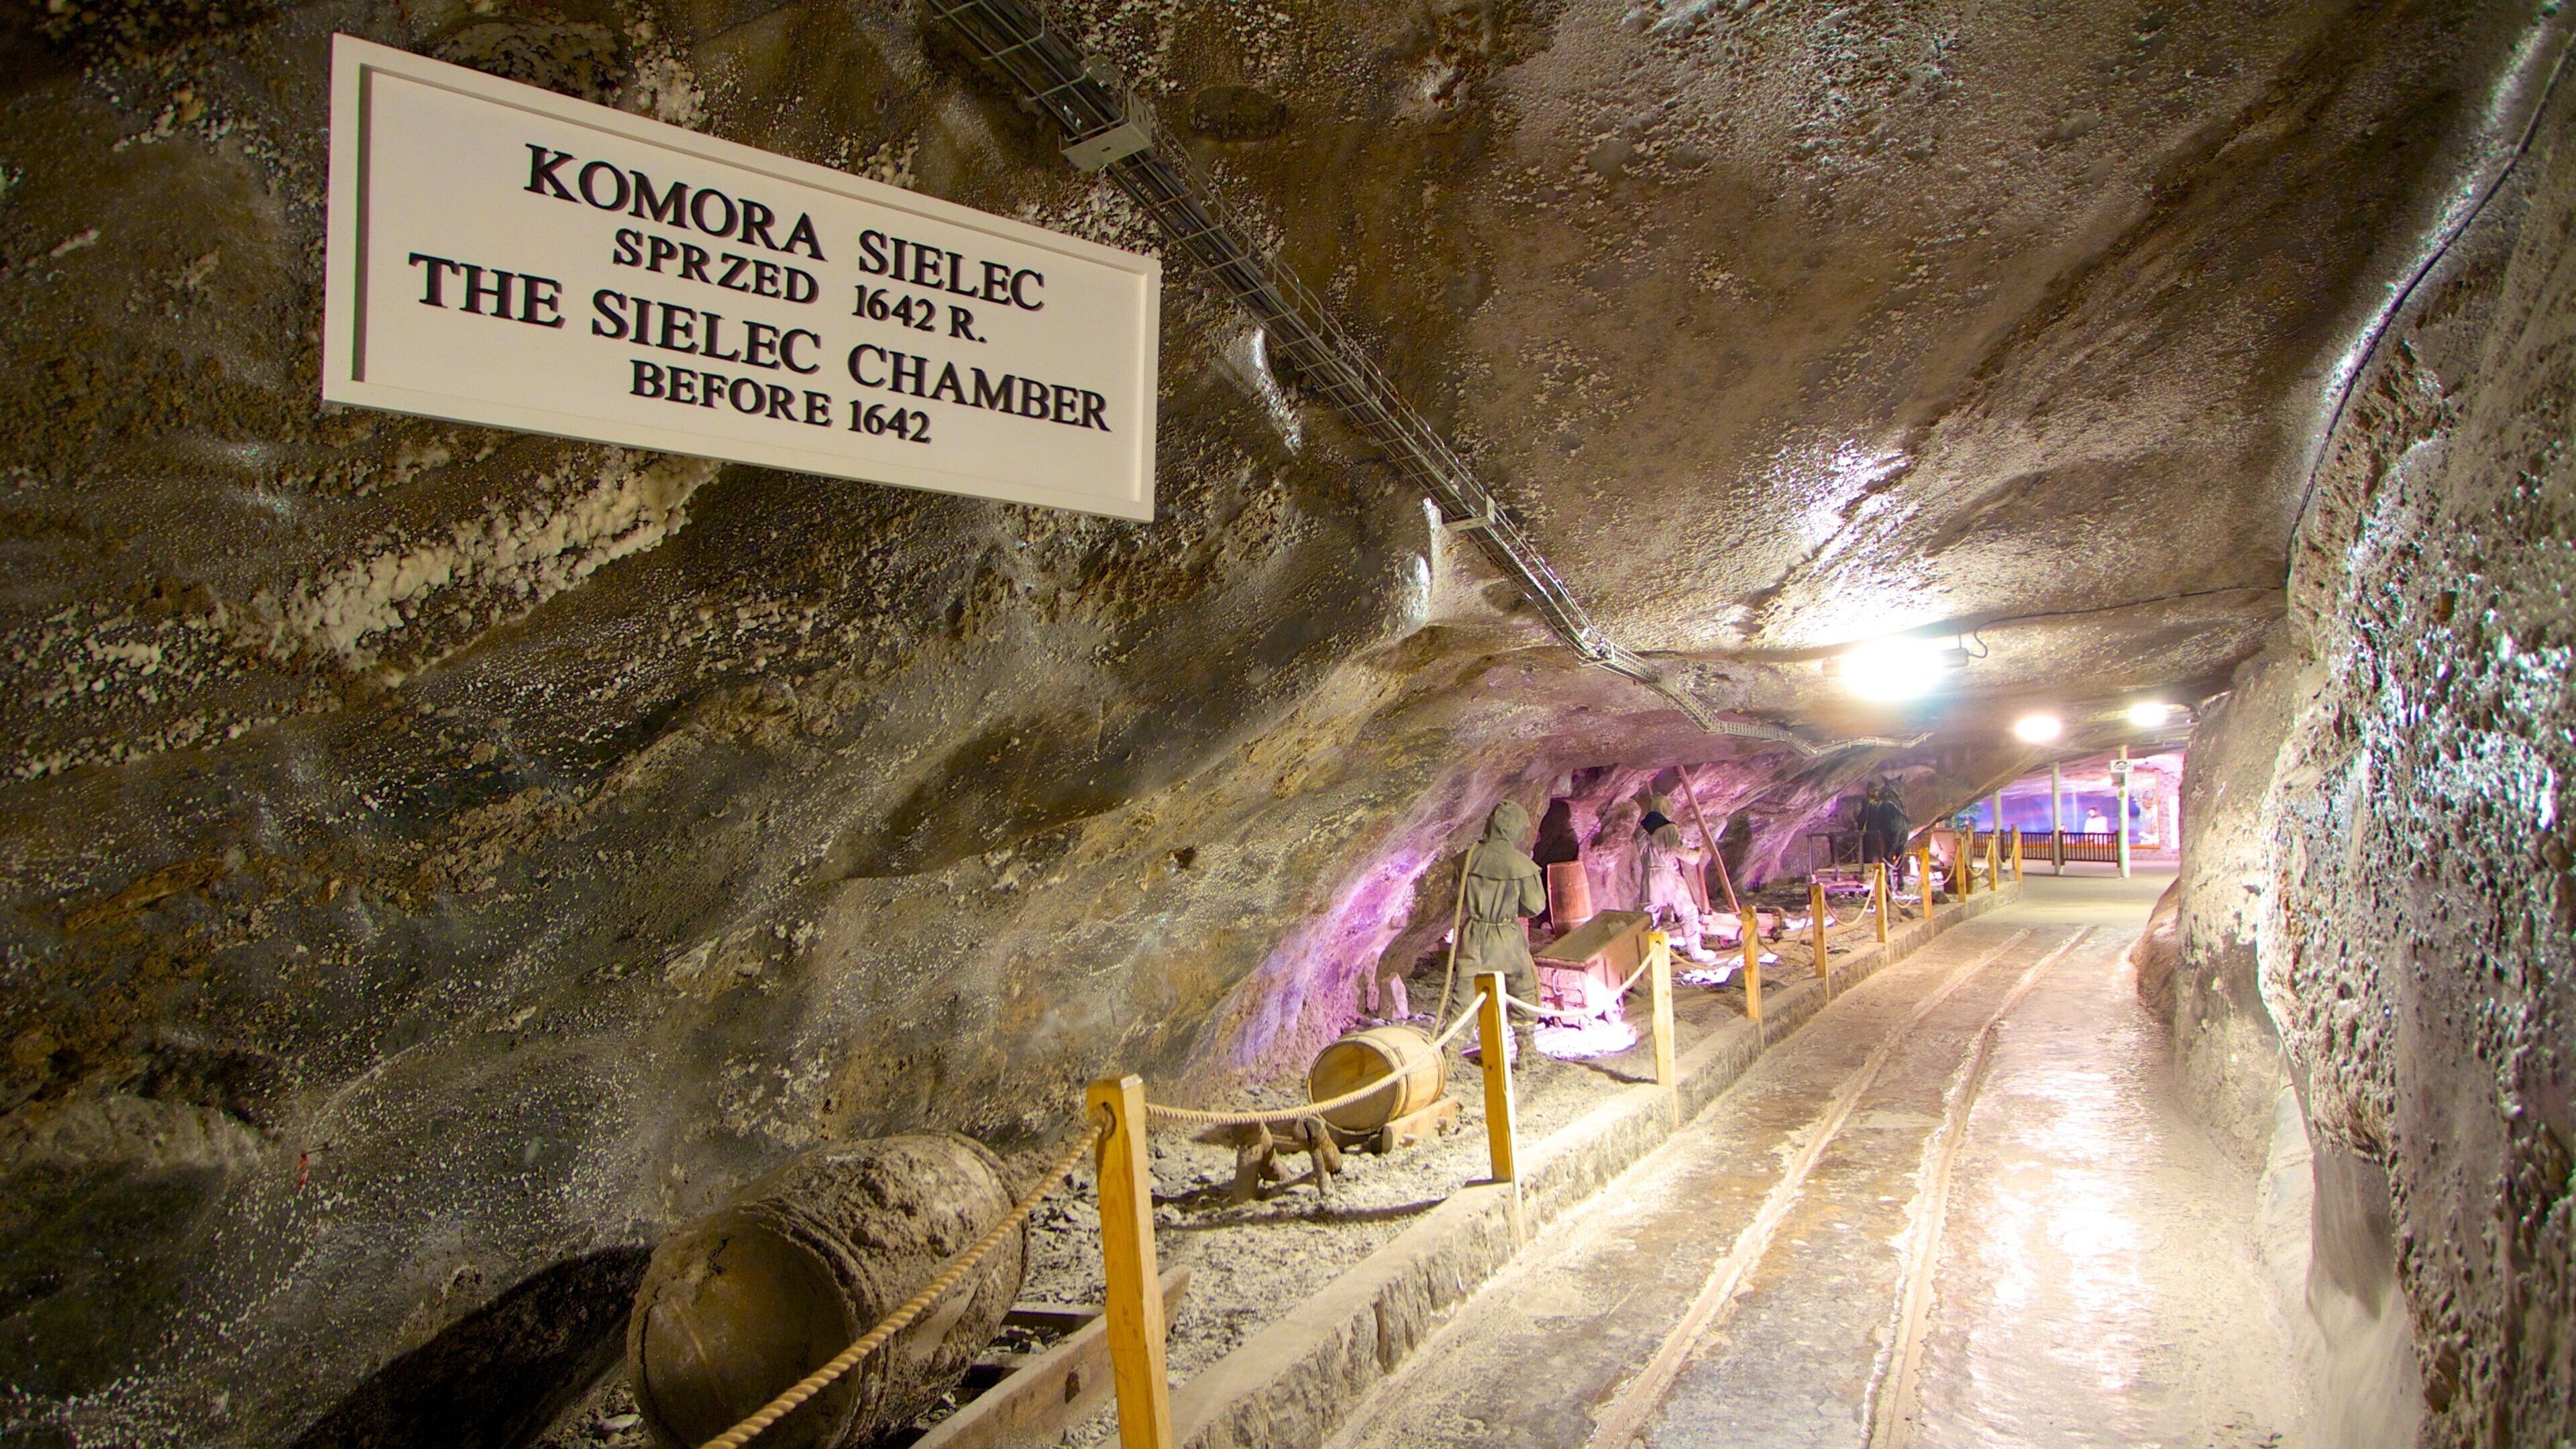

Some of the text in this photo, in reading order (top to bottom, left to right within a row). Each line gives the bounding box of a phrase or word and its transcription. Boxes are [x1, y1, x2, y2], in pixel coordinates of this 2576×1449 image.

[523, 143, 1044, 311] KOMORA SIELEC
[612, 228, 987, 343] SPRZED 1642 R.
[408, 252, 1112, 432] THE SIELEC CHAMBER
[629, 359, 932, 444] BEFORE 1642
